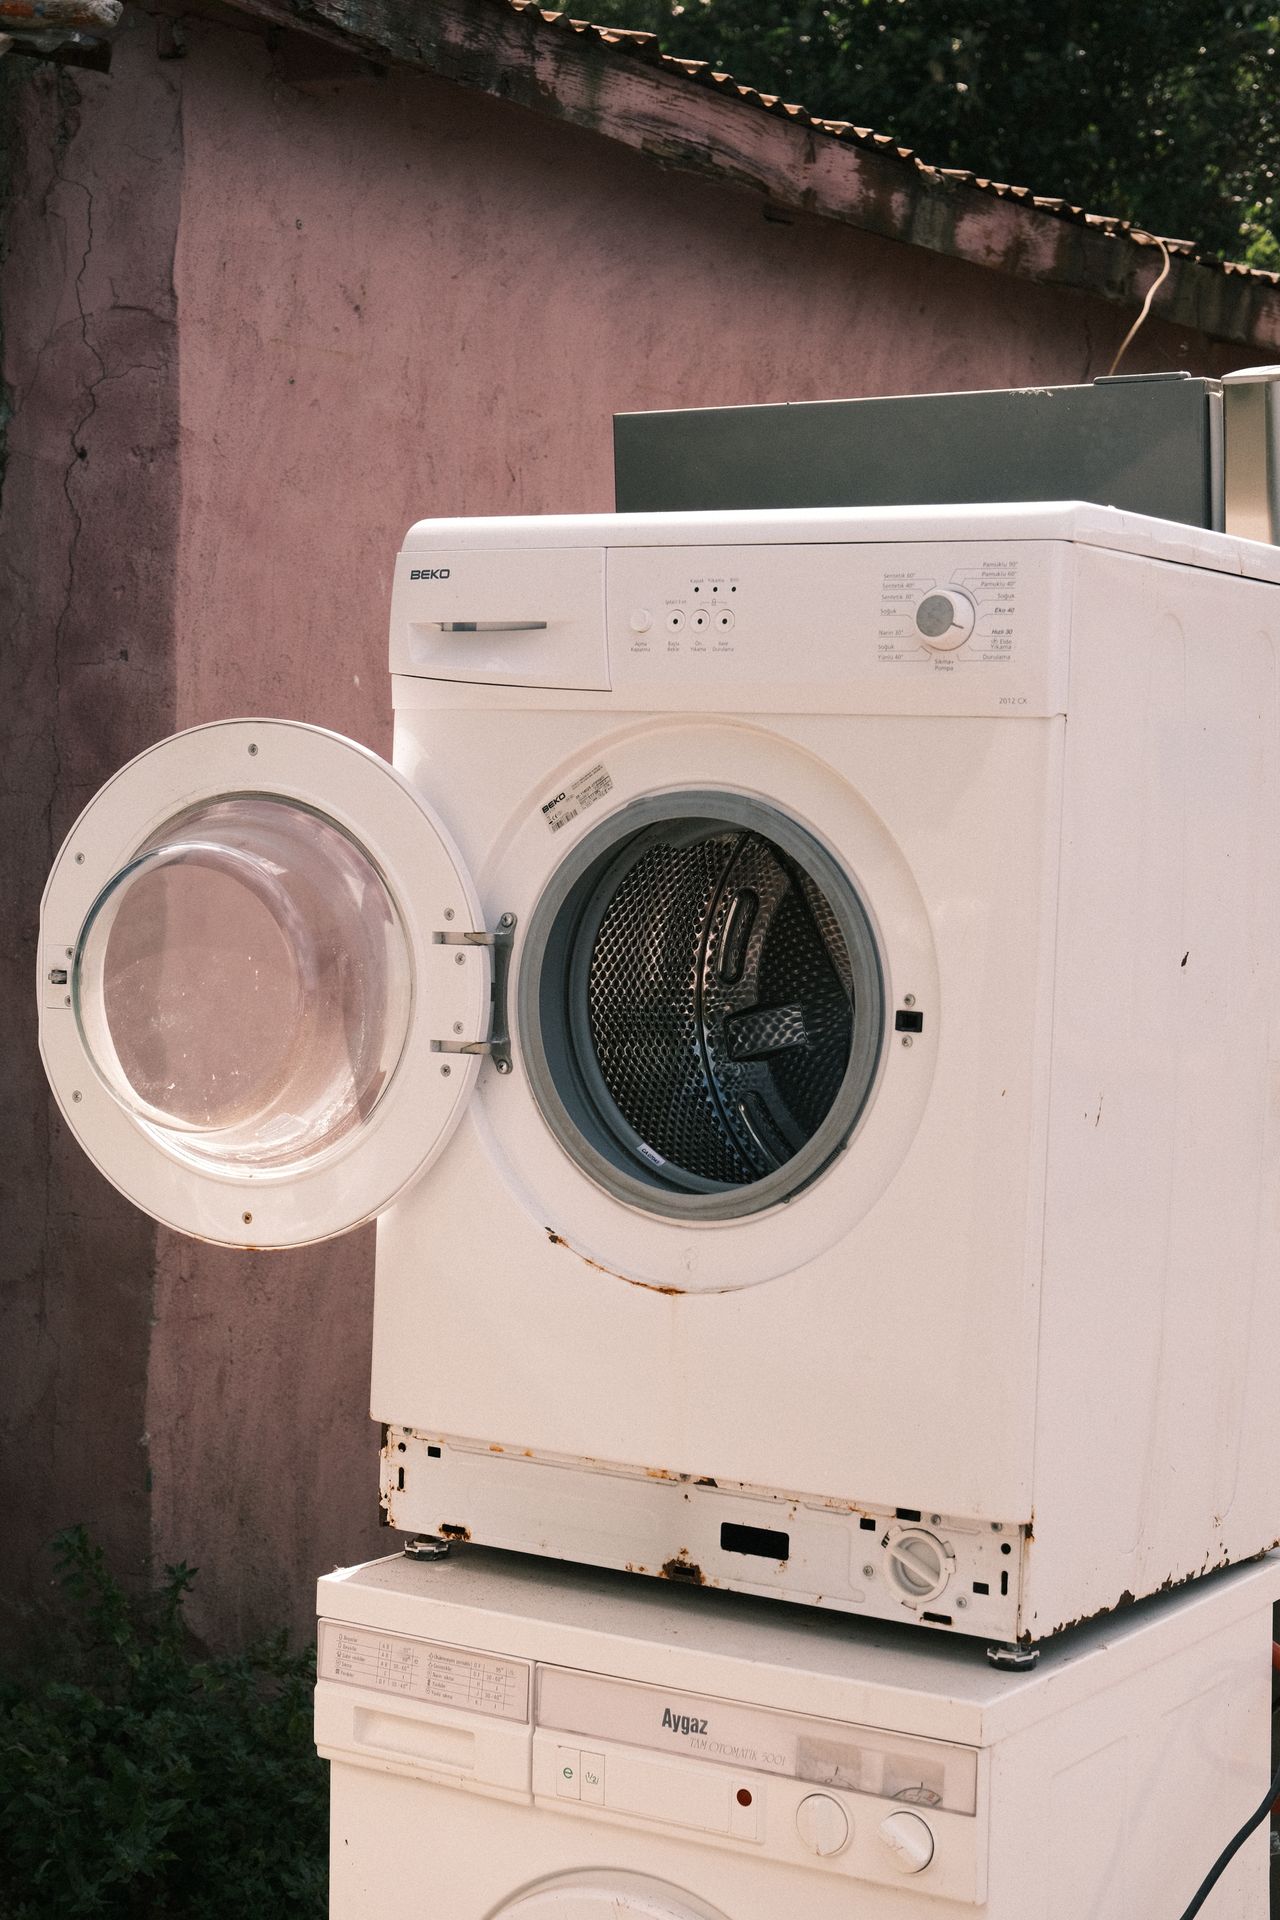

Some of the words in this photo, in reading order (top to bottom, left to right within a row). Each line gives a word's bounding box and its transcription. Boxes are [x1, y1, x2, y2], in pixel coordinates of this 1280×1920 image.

[410, 569, 450, 580] BEKO
[542, 792, 566, 813] BEKO
[661, 1707, 709, 1736] Aygaz
